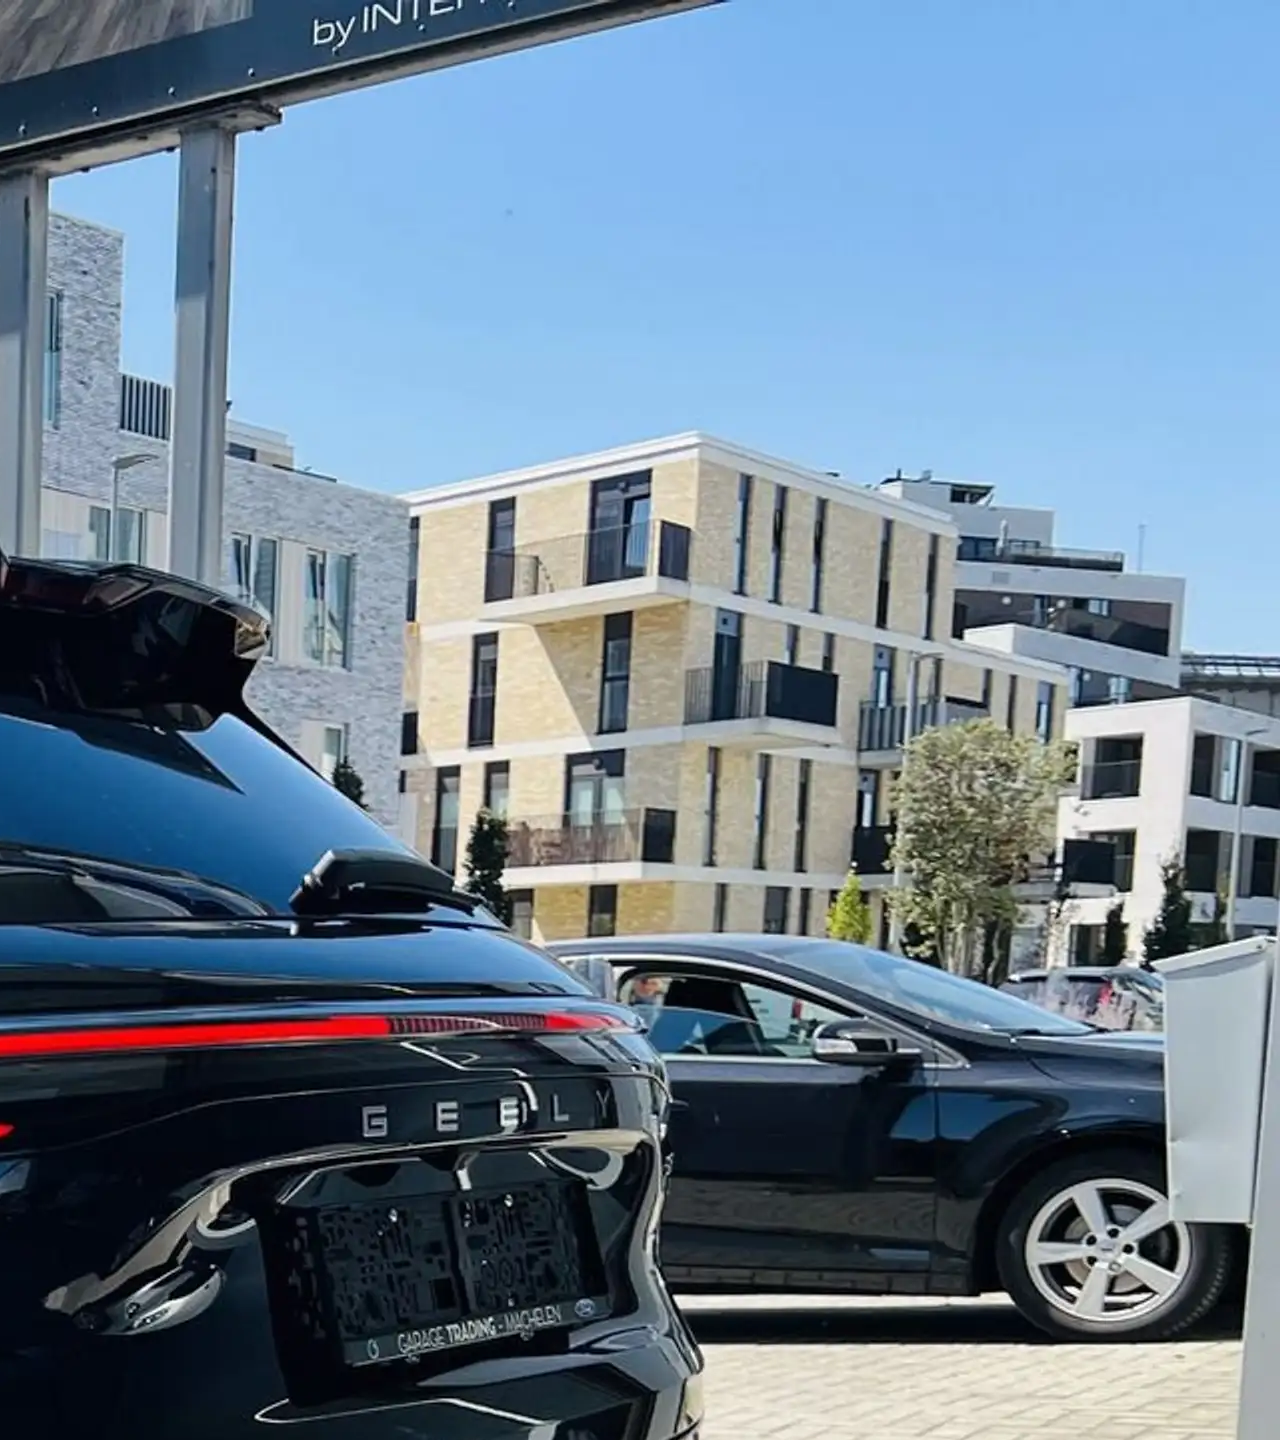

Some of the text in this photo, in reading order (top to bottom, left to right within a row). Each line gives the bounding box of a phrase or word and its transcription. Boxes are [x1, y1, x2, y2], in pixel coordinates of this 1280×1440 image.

[313, 16, 356, 53] by
[362, 1089, 610, 1137] GEELY
[397, 1325, 445, 1354] GARAGE
[446, 1316, 497, 1344] TRADING
